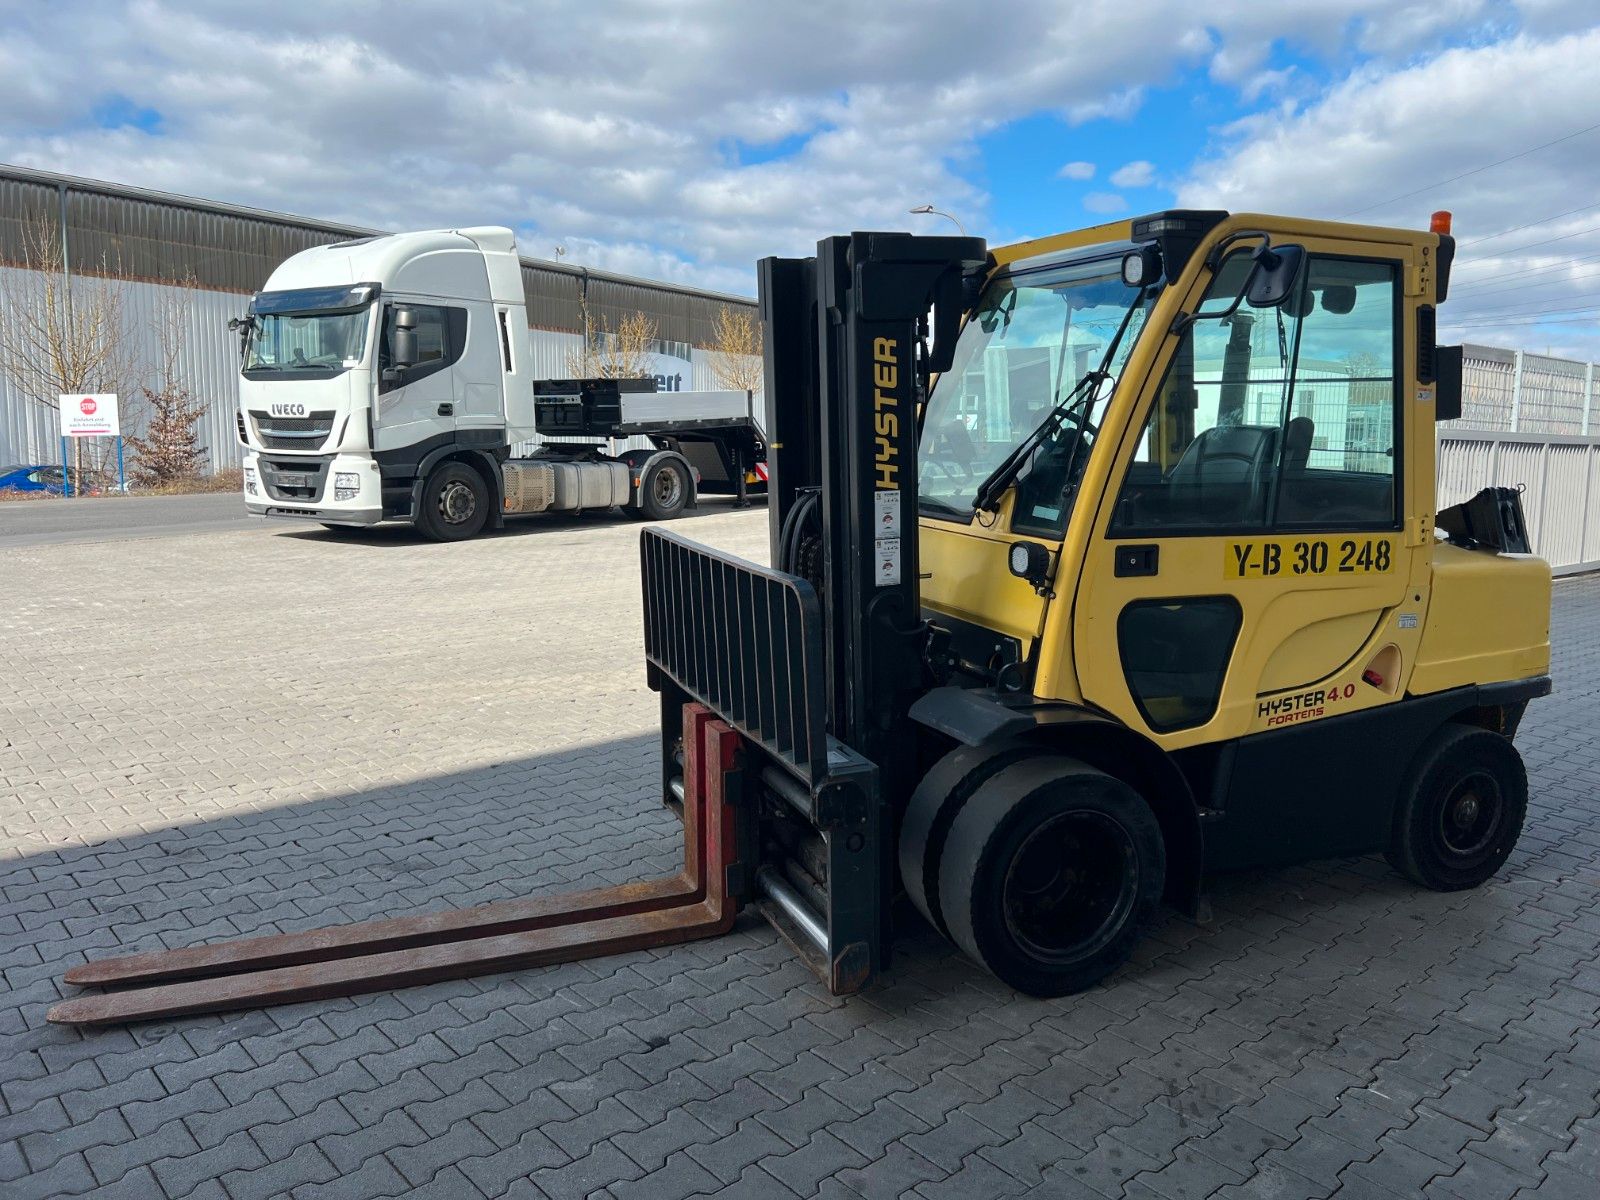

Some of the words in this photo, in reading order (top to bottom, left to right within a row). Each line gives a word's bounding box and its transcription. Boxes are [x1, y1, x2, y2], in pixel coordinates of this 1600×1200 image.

[81, 402, 96, 411] STOP
[271, 404, 305, 415] IVECO
[874, 337, 899, 489] HYSTER
[1233, 543, 1281, 576] Y-B
[1292, 541, 1329, 574] 30
[1338, 540, 1391, 572] 248
[1258, 690, 1325, 718] HYSTER
[1326, 683, 1356, 702] 4.0
[1267, 707, 1325, 727] FORTENS
